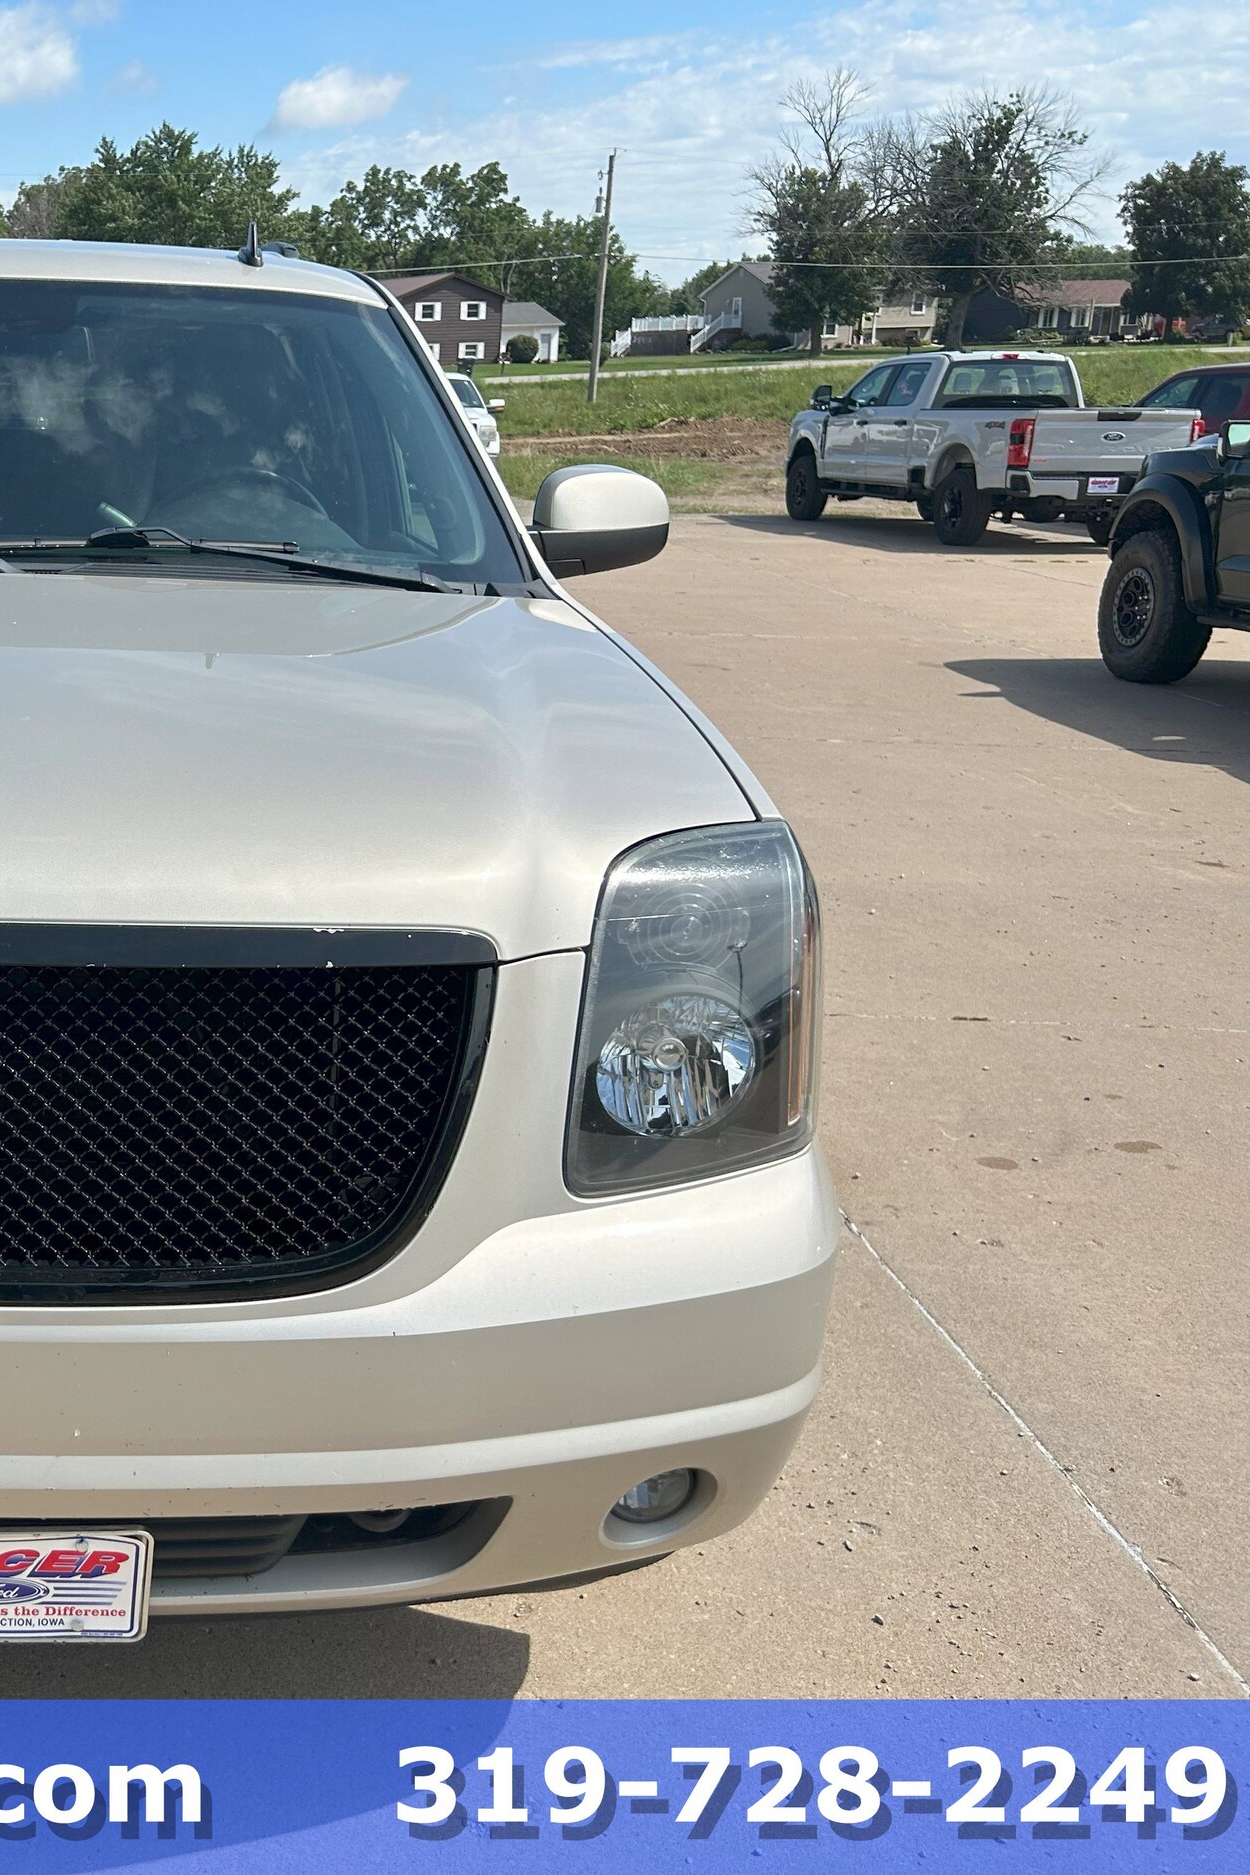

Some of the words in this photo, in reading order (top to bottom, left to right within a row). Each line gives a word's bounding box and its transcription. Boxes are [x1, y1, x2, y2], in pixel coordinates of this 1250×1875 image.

[14, 1606, 40, 1616] the
[45, 1606, 126, 1617] Difference
[38, 1618, 65, 1626] IOWA
